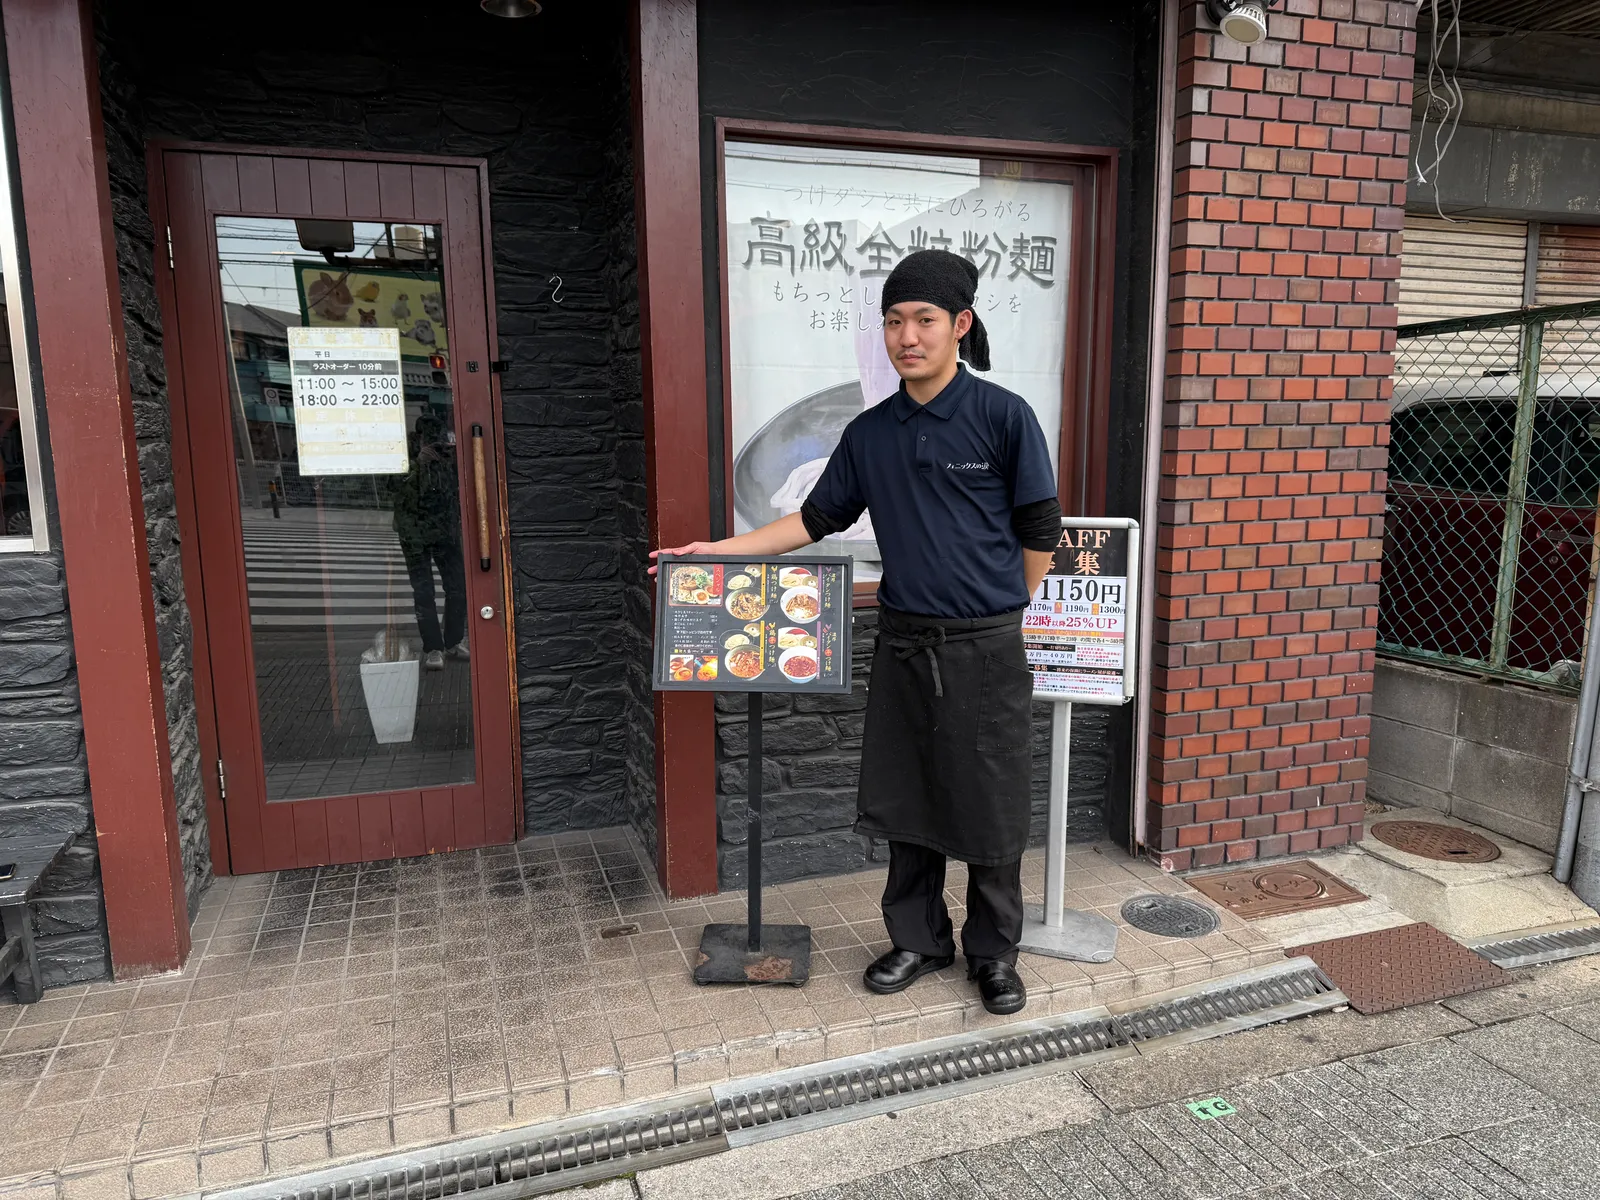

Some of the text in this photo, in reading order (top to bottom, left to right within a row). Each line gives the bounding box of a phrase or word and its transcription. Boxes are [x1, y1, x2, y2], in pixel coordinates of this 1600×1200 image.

[785, 184, 1030, 222] つけダシと共にひろがる
[312, 363, 382, 371] ラストオーダー 10分前
[298, 378, 336, 390] 11:00
[361, 378, 398, 390] 15:00
[299, 394, 337, 406] 18:00
[361, 394, 400, 406] 22:00
[1056, 529, 1111, 549] AFF
[1041, 578, 1121, 604] 1150円
[1065, 605, 1089, 613] 1190円
